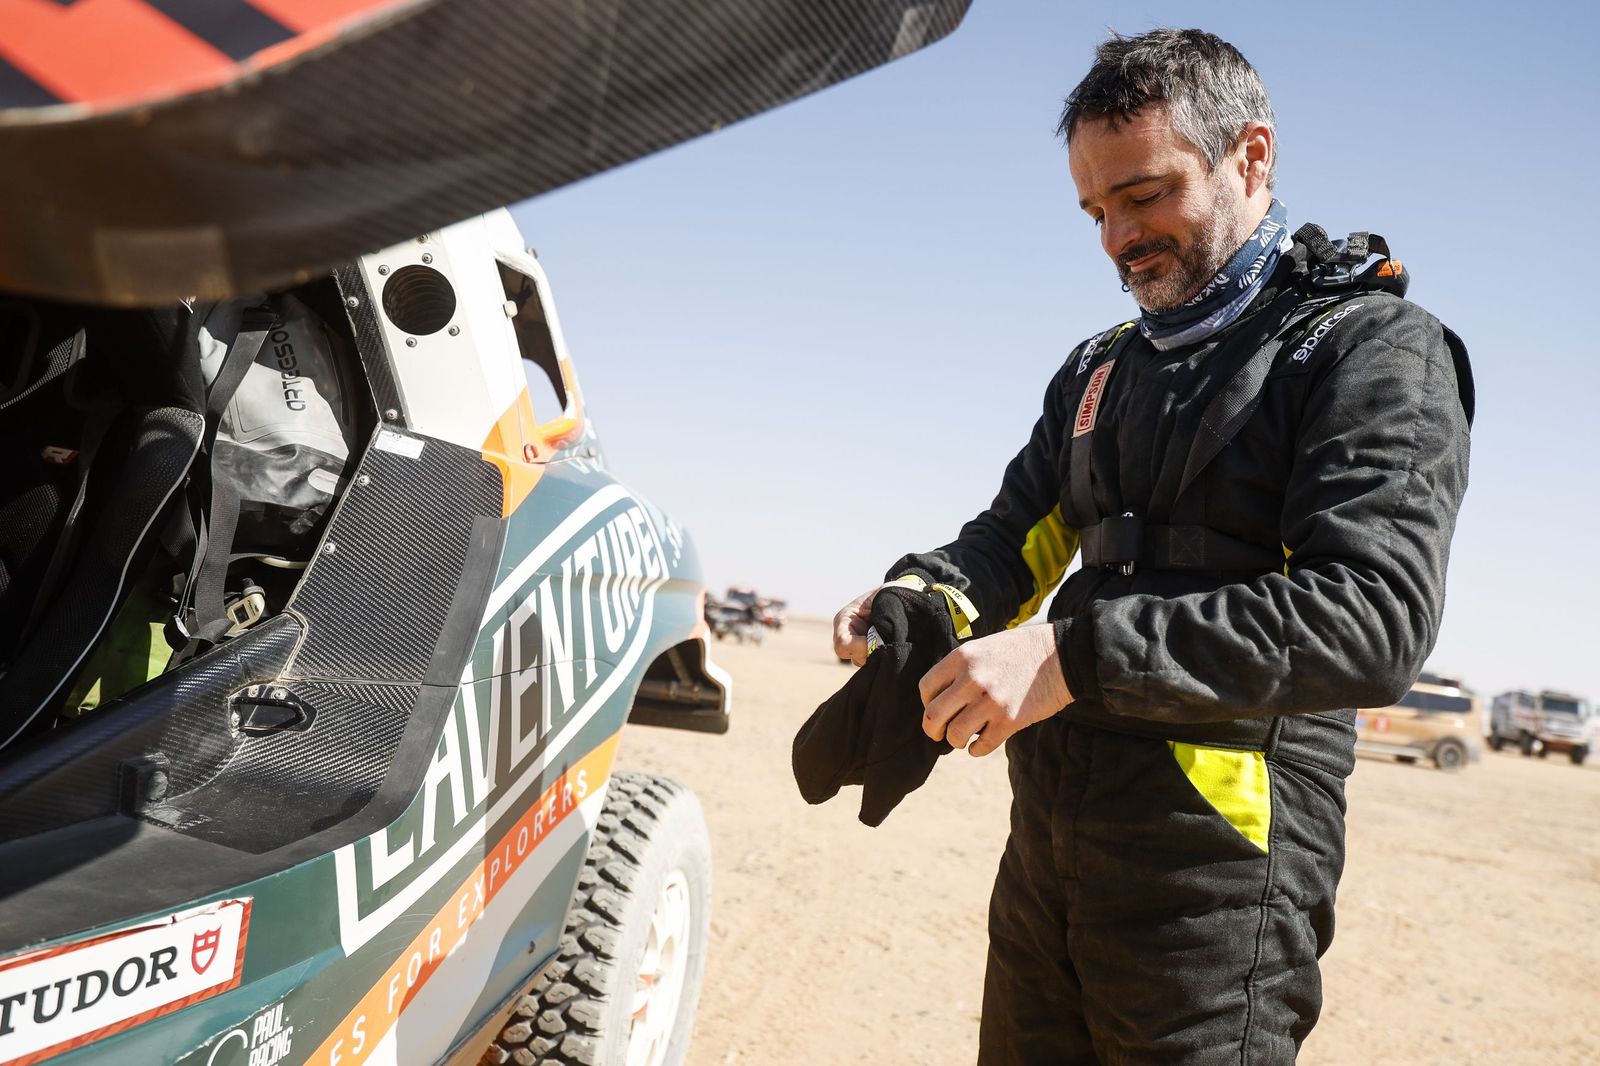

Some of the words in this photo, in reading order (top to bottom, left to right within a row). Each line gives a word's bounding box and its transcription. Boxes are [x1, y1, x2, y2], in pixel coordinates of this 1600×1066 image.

[1080, 370, 1106, 427] SIMPSON
[388, 927, 441, 1014] FOR
[458, 769, 588, 929] EXPLORERS
[0, 946, 178, 1036] TUDOR
[251, 1002, 284, 1049] PAUL
